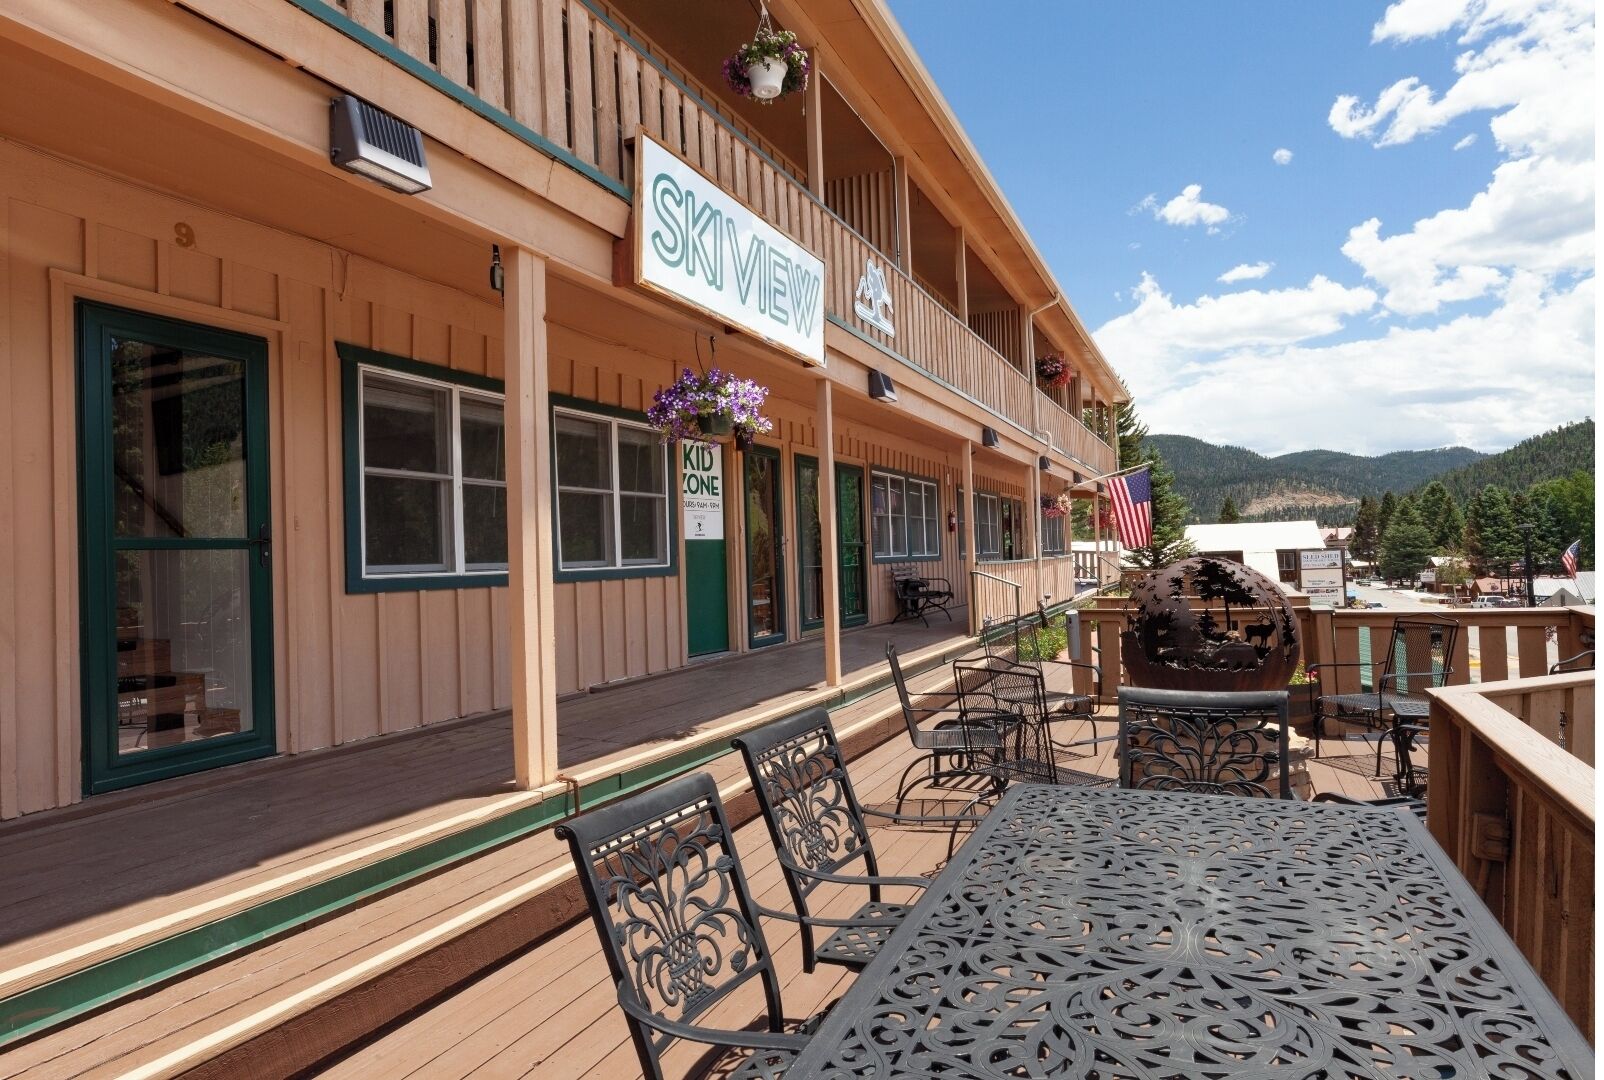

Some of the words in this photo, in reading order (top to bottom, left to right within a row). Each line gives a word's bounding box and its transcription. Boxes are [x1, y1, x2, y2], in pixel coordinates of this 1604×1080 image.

[174, 222, 196, 248] 9
[683, 444, 714, 472] KID
[682, 473, 720, 496] ZONE
